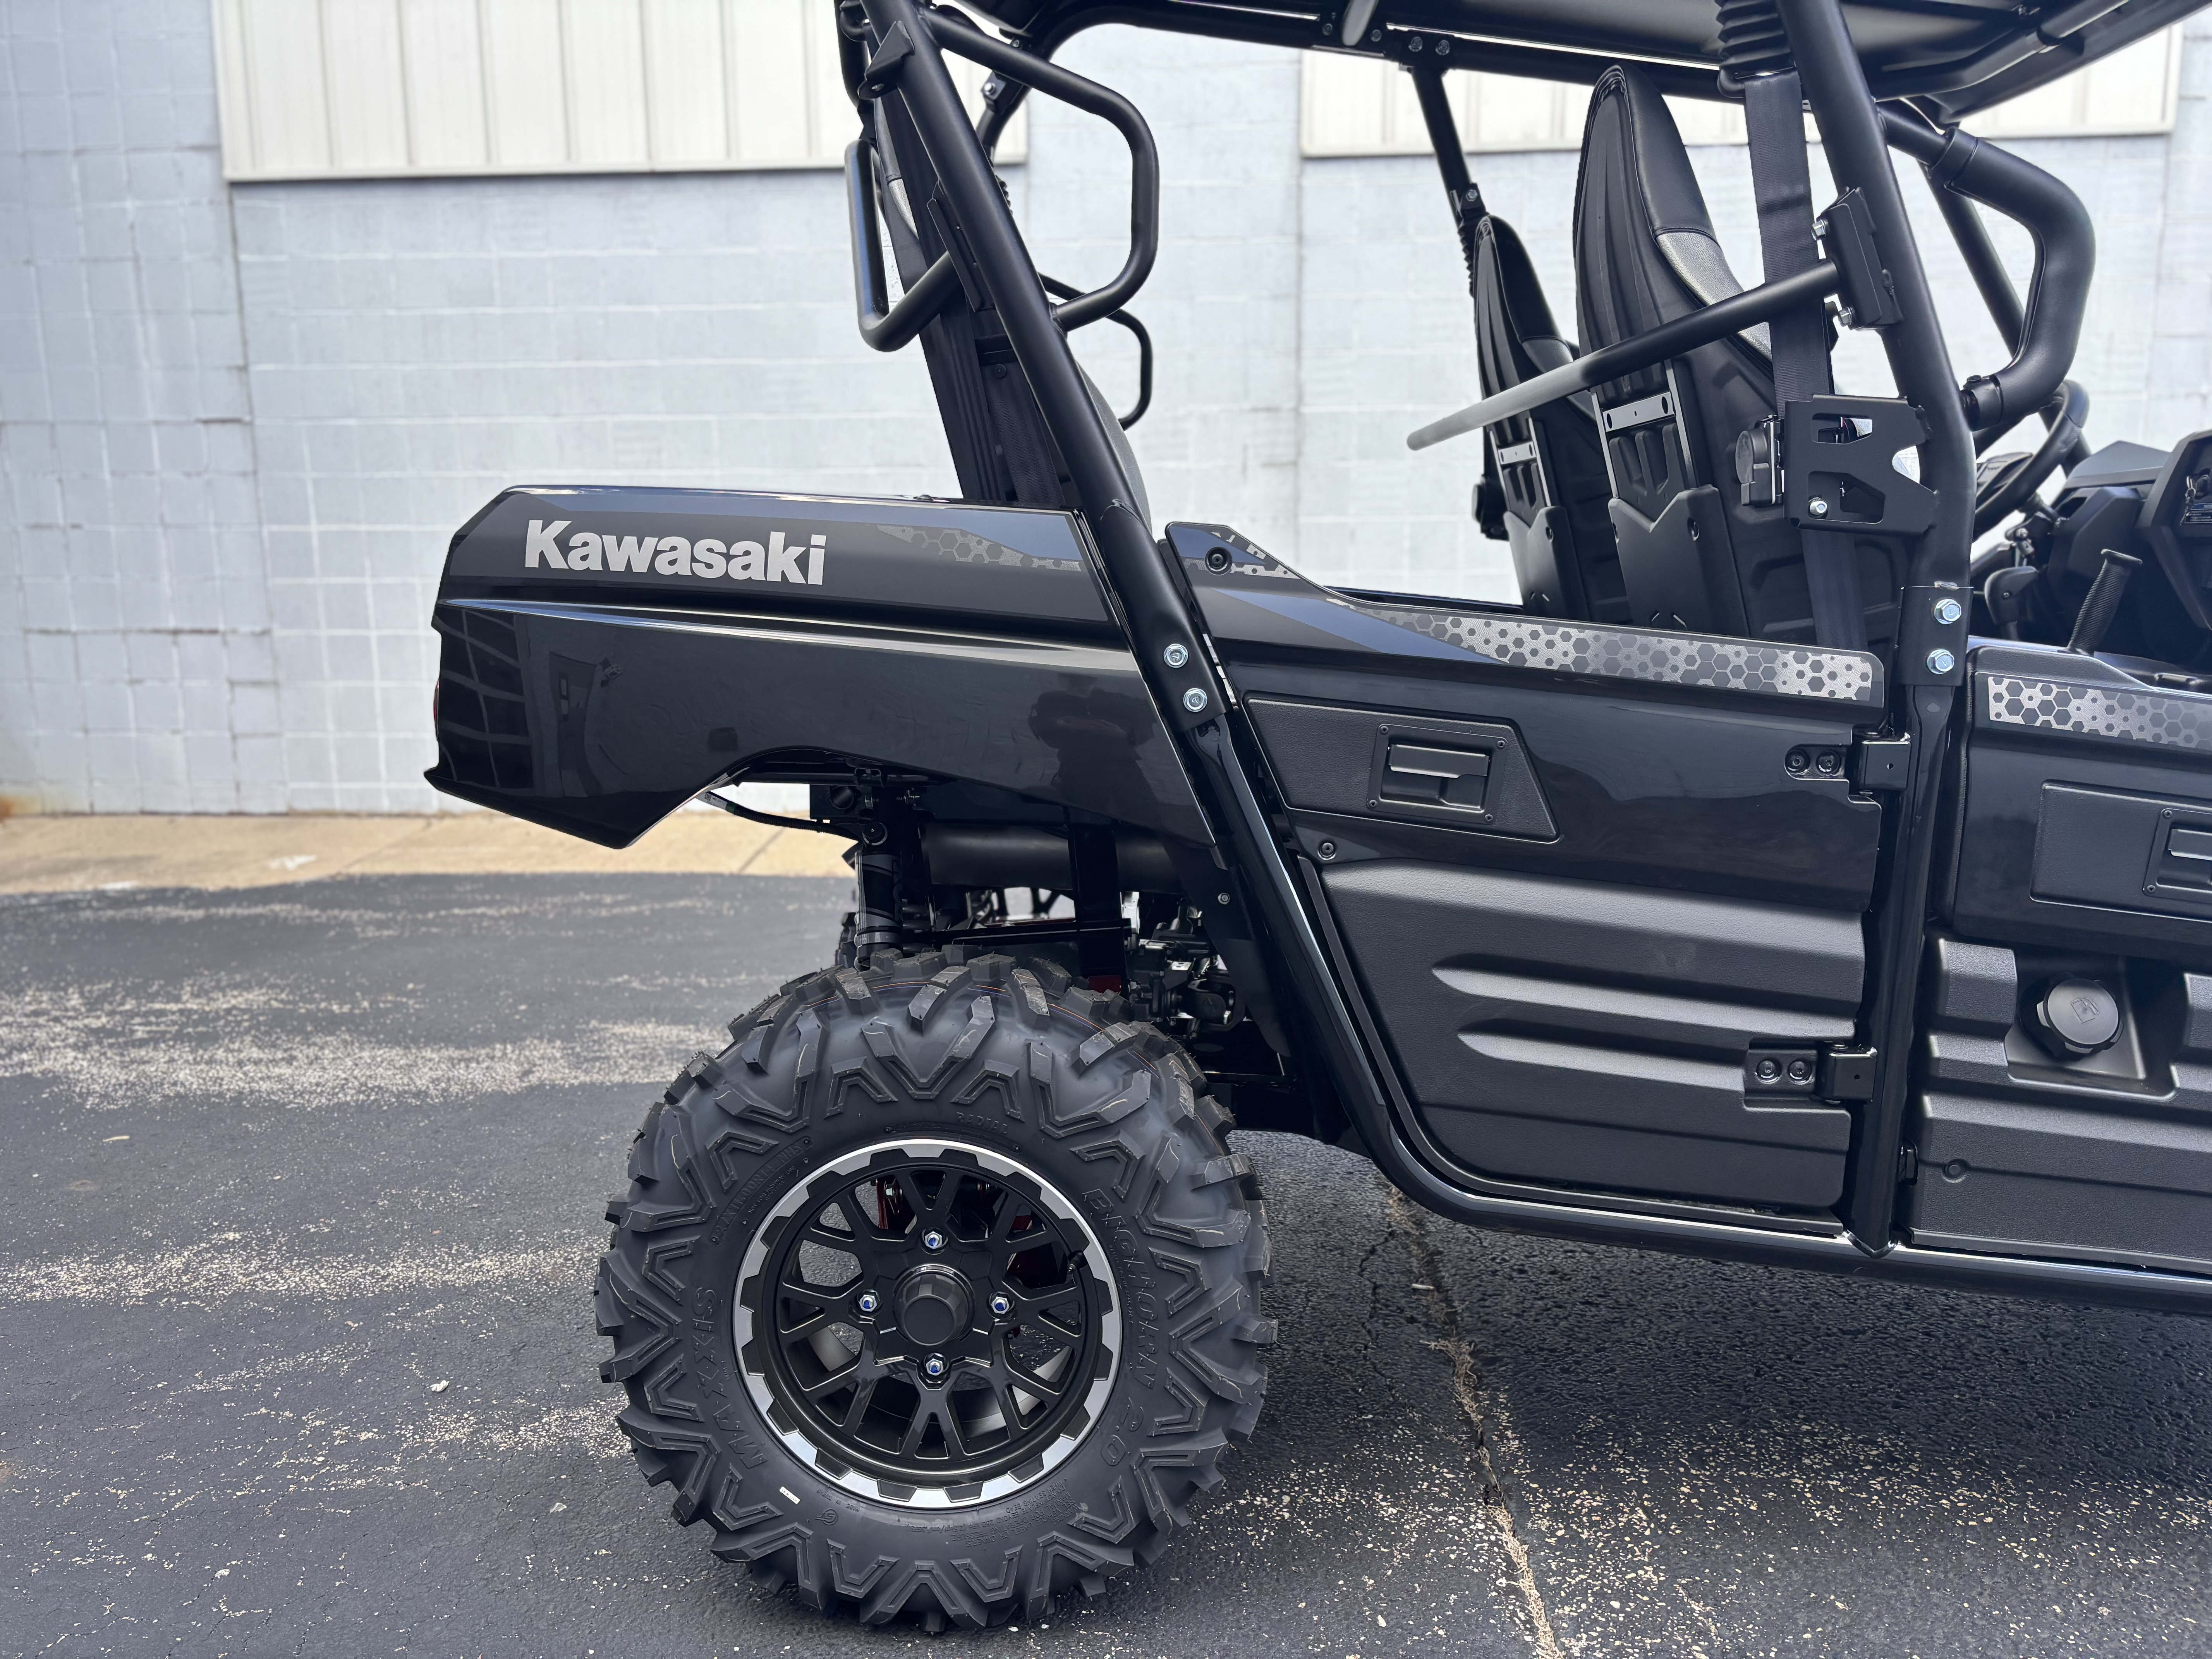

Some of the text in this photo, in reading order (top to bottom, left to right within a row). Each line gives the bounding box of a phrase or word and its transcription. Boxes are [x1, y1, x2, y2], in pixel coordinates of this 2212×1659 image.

[525, 520, 826, 585] Kawasaki
[956, 1111, 1009, 1134] RADIAL
[757, 1192, 767, 1203] FOR
[785, 1165, 797, 1175] USE
[1081, 1188, 1159, 1389] BIGHORN
[692, 1287, 768, 1468] MAXXIS
[1100, 1396, 1144, 1466] 2.0
[1006, 1480, 1063, 1514] WHEN SEATING BEAD
[1046, 1491, 1058, 1502] NOT
[1056, 1485, 1066, 1494] DO
[846, 1503, 860, 1512] MADE
[1021, 1499, 1044, 1515] INFLATE
[1044, 1491, 1072, 1512] MANUAL
[965, 1498, 1076, 1548] SEE VEHICLE LABEL OR OWNER'S
[996, 1511, 1019, 1523] BEYOND
[1029, 1508, 1045, 1520] FOR
[1052, 1504, 1080, 1525] WARNING
[989, 1515, 1029, 1535] OPERATING
